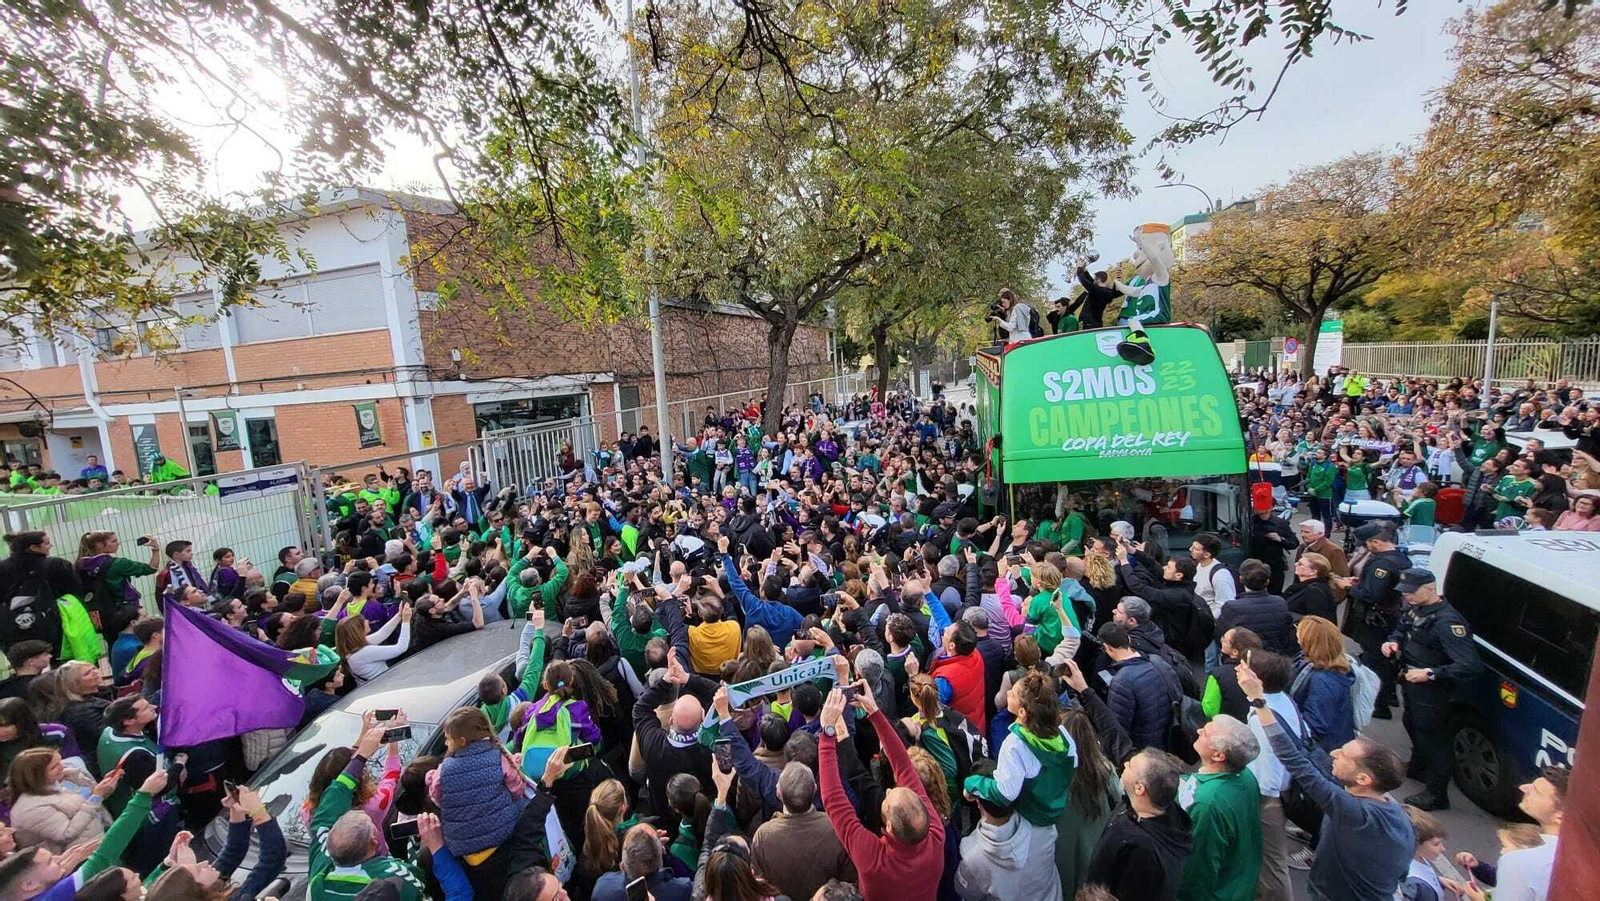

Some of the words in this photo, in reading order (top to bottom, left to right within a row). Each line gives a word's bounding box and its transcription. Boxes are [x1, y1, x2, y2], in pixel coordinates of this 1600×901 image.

[1159, 360, 1197, 376] 22
[1042, 364, 1156, 403] S2MOS
[1160, 375, 1197, 392] 23
[1029, 394, 1222, 447] CAMPEONES
[1061, 435, 1107, 452] COPA
[1110, 433, 1151, 450] DEL
[1151, 431, 1191, 447] REY
[770, 661, 831, 686] Unicaja
